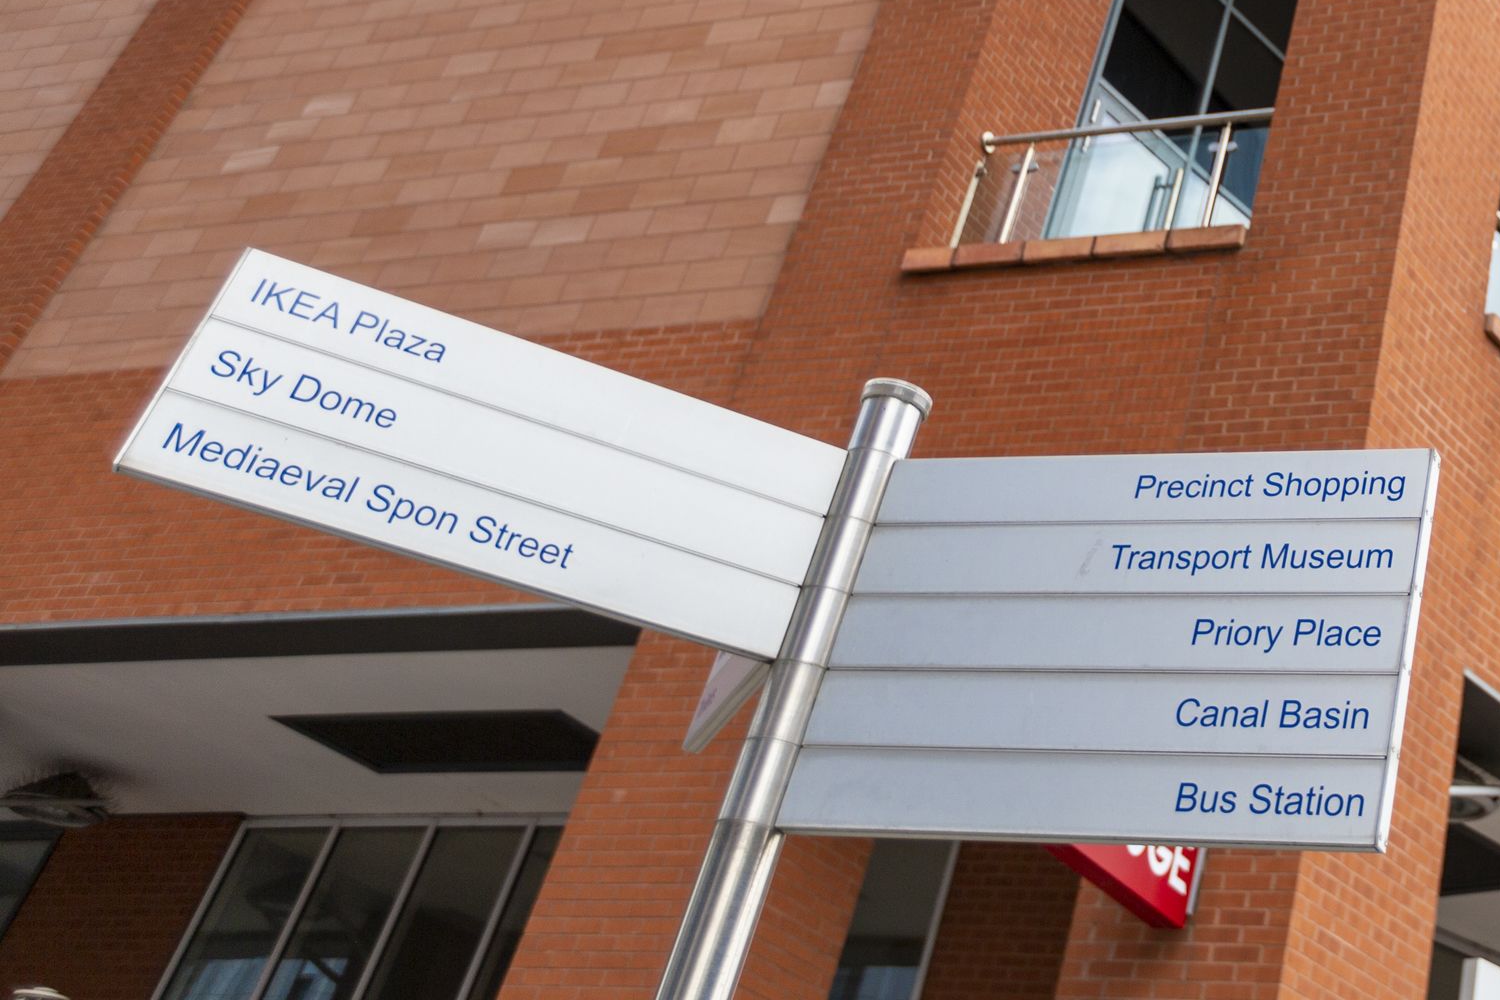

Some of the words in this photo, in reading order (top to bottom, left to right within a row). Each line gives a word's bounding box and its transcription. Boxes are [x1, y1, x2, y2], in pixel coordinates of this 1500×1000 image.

[250, 279, 340, 329] IKEA
[349, 311, 446, 362] Plaza
[209, 349, 284, 397] Sky
[288, 374, 398, 429] Dome
[161, 422, 361, 503] Mediaeval
[365, 483, 460, 536] Spon
[467, 515, 574, 569] Street
[1135, 472, 1254, 499] Precinct
[1263, 471, 1406, 503] Shopping
[1111, 542, 1253, 576] Transport
[1260, 542, 1393, 568] Museum
[1190, 617, 1285, 653] Priory
[1292, 617, 1382, 647] Place
[1174, 697, 1270, 728] Canal
[1279, 698, 1370, 730] Basin
[1174, 780, 1237, 815] Bus
[1248, 782, 1365, 817] Station
